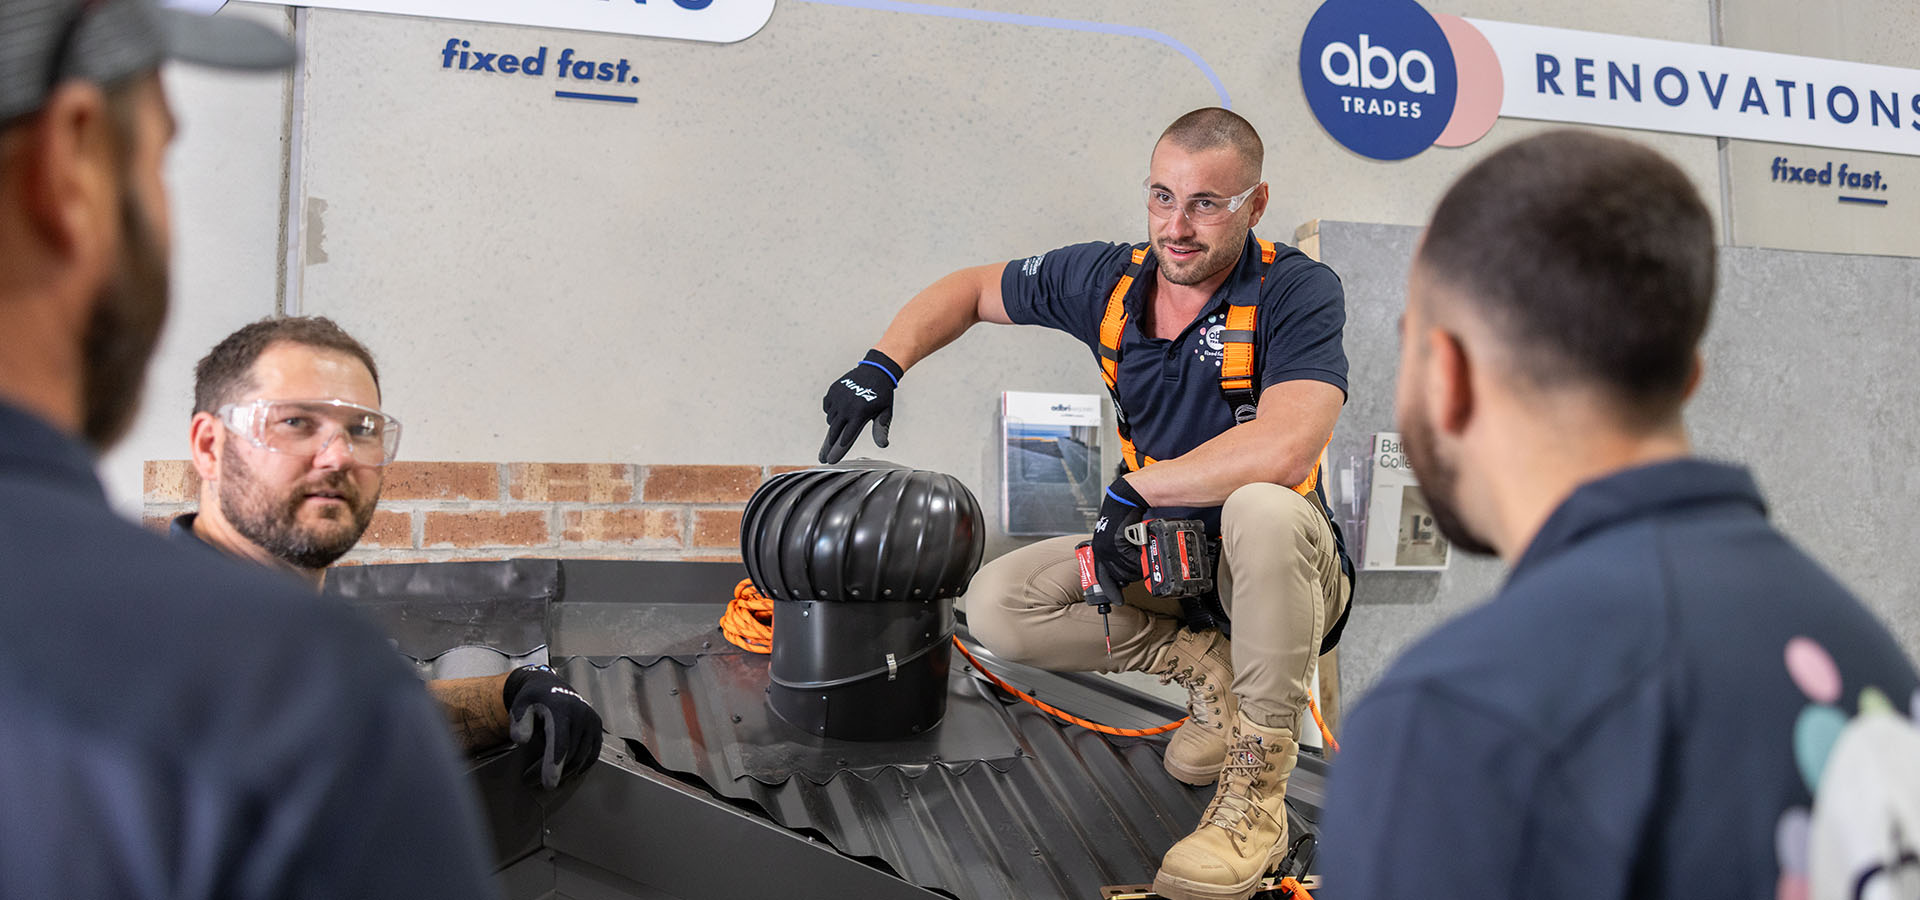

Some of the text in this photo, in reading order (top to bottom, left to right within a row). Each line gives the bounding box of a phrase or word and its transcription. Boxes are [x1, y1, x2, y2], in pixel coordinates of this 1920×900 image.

[442, 38, 639, 84] fixed fast.
[1320, 34, 1436, 94] aba
[1341, 96, 1422, 119] TRADES
[1771, 156, 1887, 190] fixed fast.
[841, 378, 878, 402] NINJA
[1381, 439, 1404, 453] Bat
[1380, 454, 1413, 469] Colle
